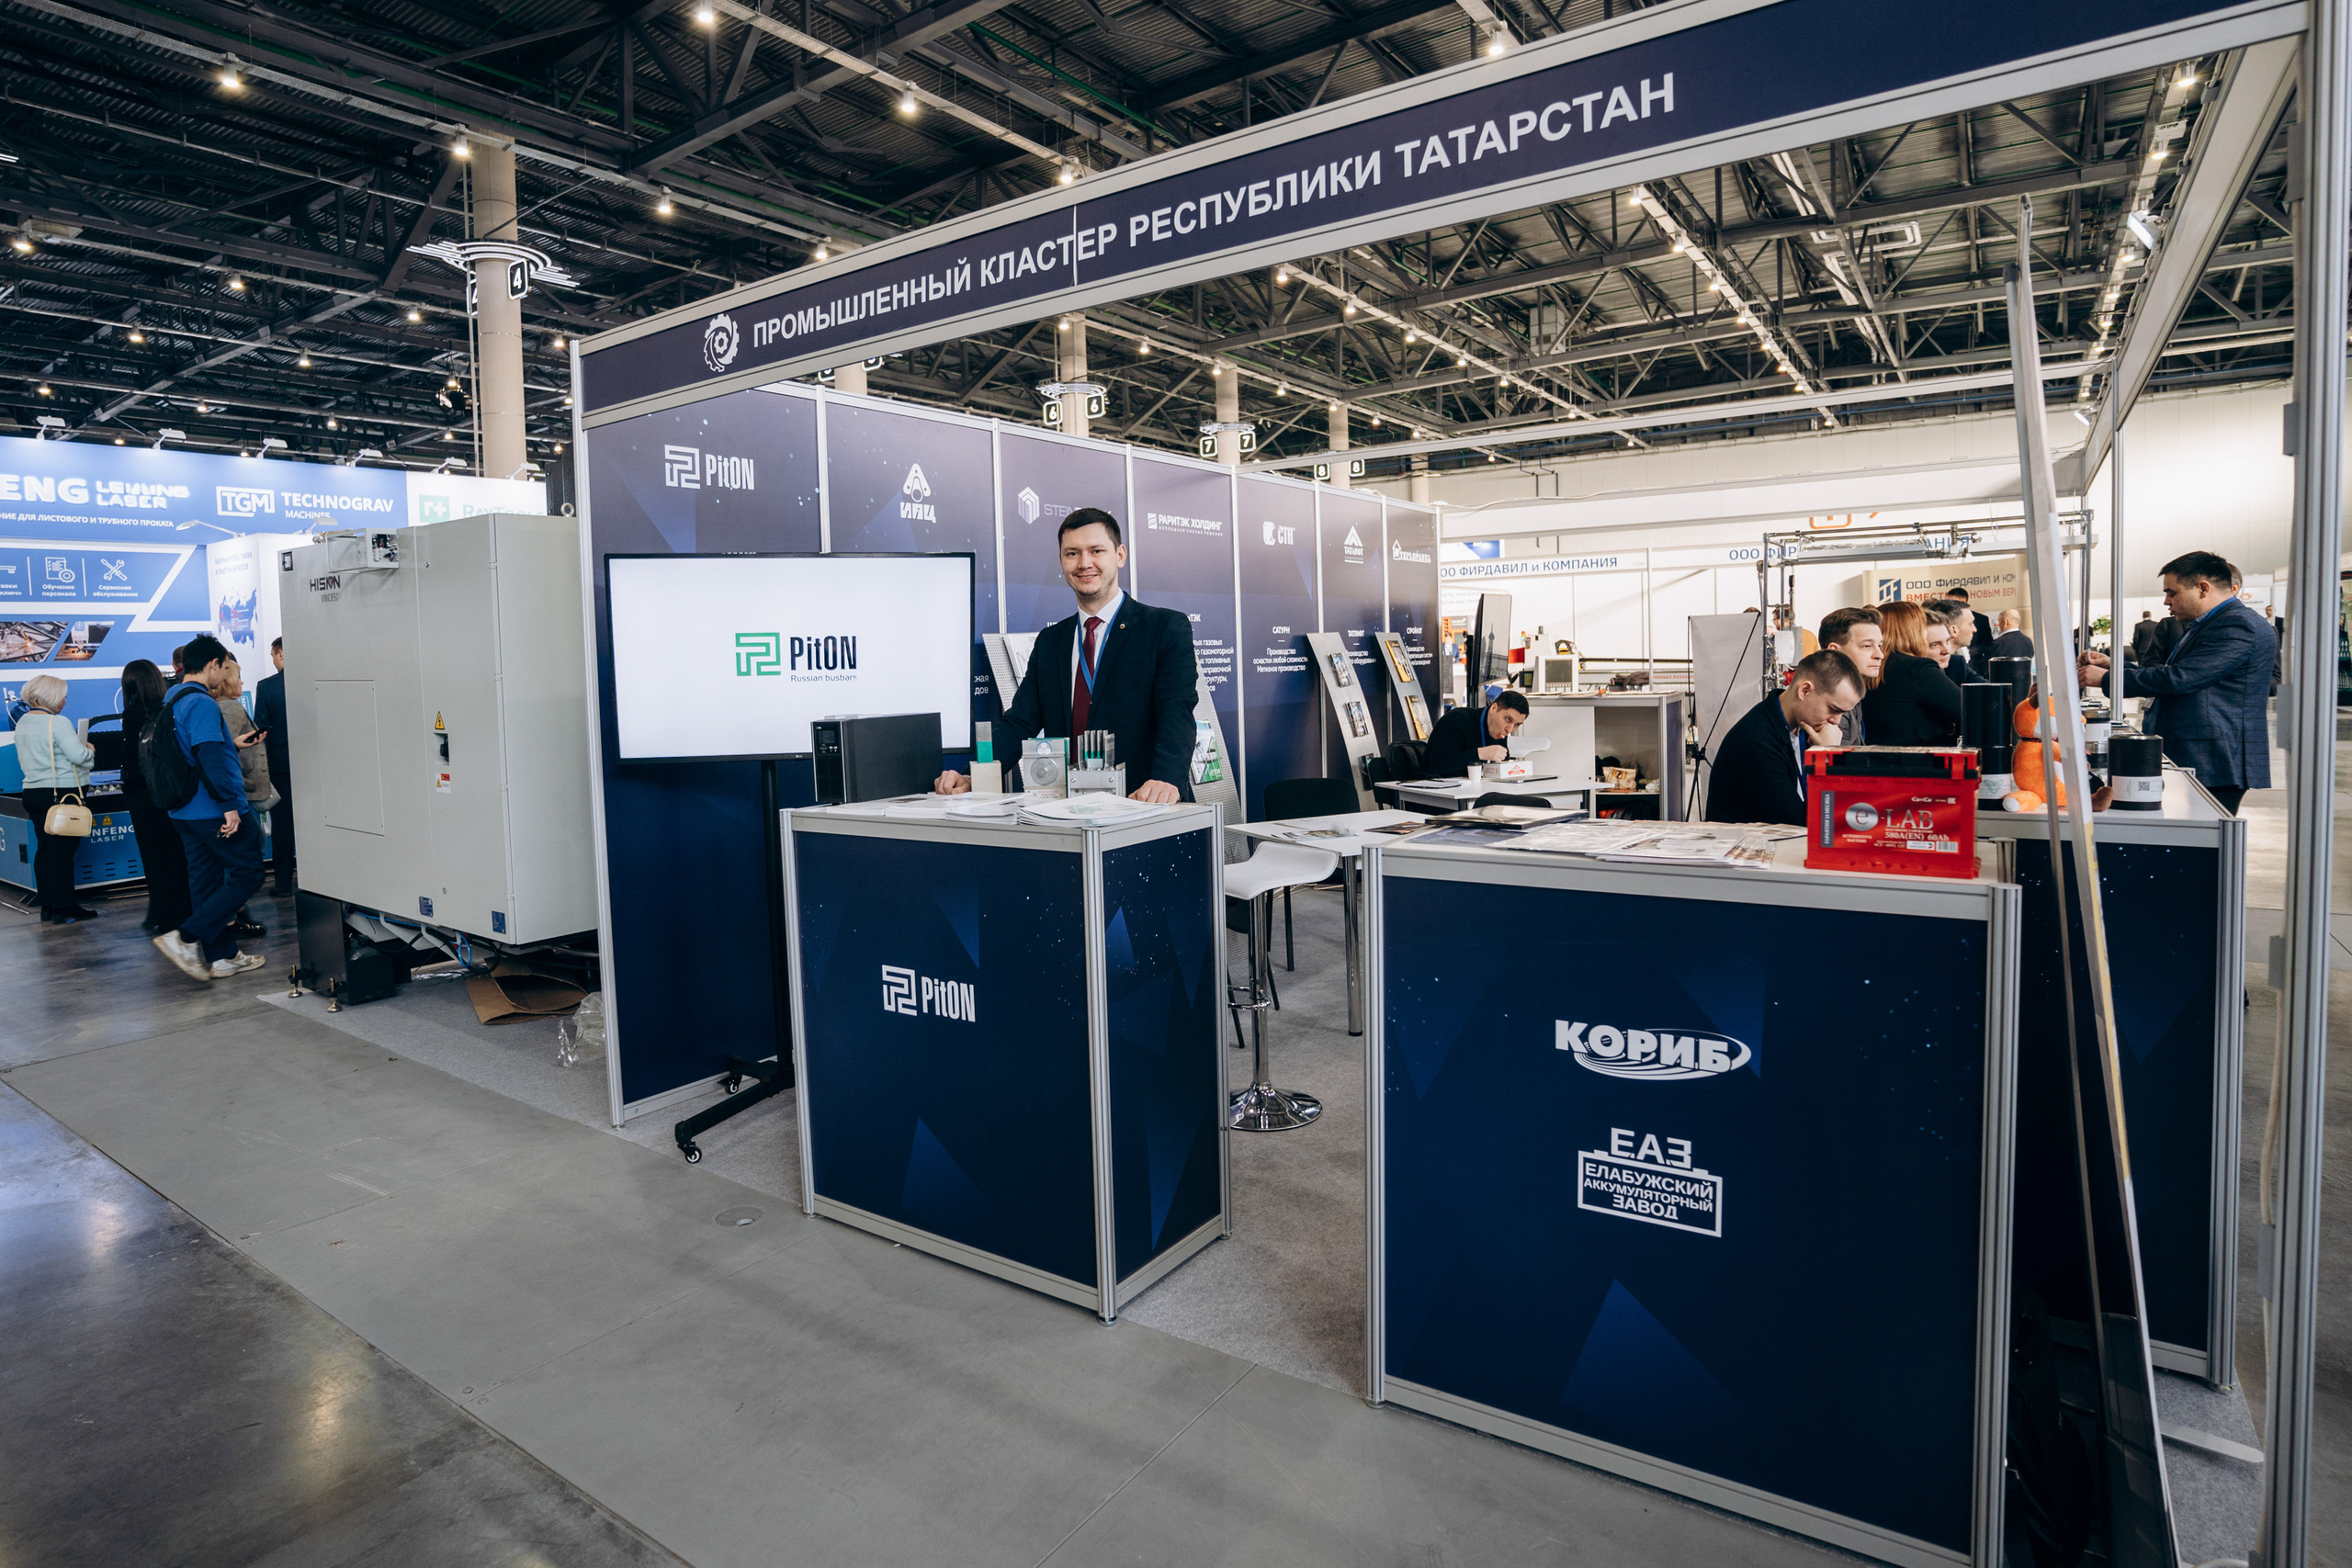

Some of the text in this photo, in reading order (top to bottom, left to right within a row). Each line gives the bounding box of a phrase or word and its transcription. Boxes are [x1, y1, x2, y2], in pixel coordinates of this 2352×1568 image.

[753, 72, 1676, 349] ПРОМЫШЛЕННЫЙ КЛАСТЕР РЕСПУБЛИКИ ТАТАРСТАН
[513, 267, 523, 289] 4
[1049, 405, 1057, 422] 6
[1091, 399, 1099, 413] 6
[1204, 440, 1215, 453] 7
[1242, 434, 1251, 448] 7
[706, 453, 755, 491] PitON
[1318, 466, 1326, 477] 8
[1353, 462, 1361, 473] 8
[96, 493, 168, 510] LASER
[221, 491, 270, 513] TGM
[280, 492, 394, 513] TECHNOGRAV
[17, 513, 36, 522] ДЛЯ
[38, 514, 89, 524] ЛИСТОВОГО
[97, 517, 139, 526] ТРУБНОГО
[140, 520, 175, 528] ПРОКАТА
[1158, 513, 1223, 531] РАРИТЭК ХОЛДИНГ
[1729, 549, 1761, 560] ООО
[1459, 563, 1529, 577] ФИРДАВИЛ
[1543, 557, 1618, 571] КОМПАНИЯ
[1905, 580, 1931, 590] ООО
[1935, 576, 1992, 588] ФИРДАВИЛ
[1993, 575, 2001, 583] И
[1905, 592, 1949, 602] ВМЕСТ
[1969, 588, 2001, 599] НОВЫМ
[1272, 626, 1291, 635] САТУРН
[790, 636, 857, 671] PitON
[1266, 648, 1296, 657] Производство
[790, 674, 823, 682] Russian
[85, 825, 135, 838] NFENG
[90, 834, 125, 843] LASER
[1927, 834, 1950, 842] 60Ah
[921, 976, 977, 1022] PitON
[1555, 1019, 1732, 1074] КОРИБ
[1585, 1162, 1713, 1200] ЕЛАБУЖСКИЙ
[1583, 1178, 1713, 1213] АККУМУЛЯТОРНЫЙ
[1611, 1193, 1679, 1221] ЗАВОД
